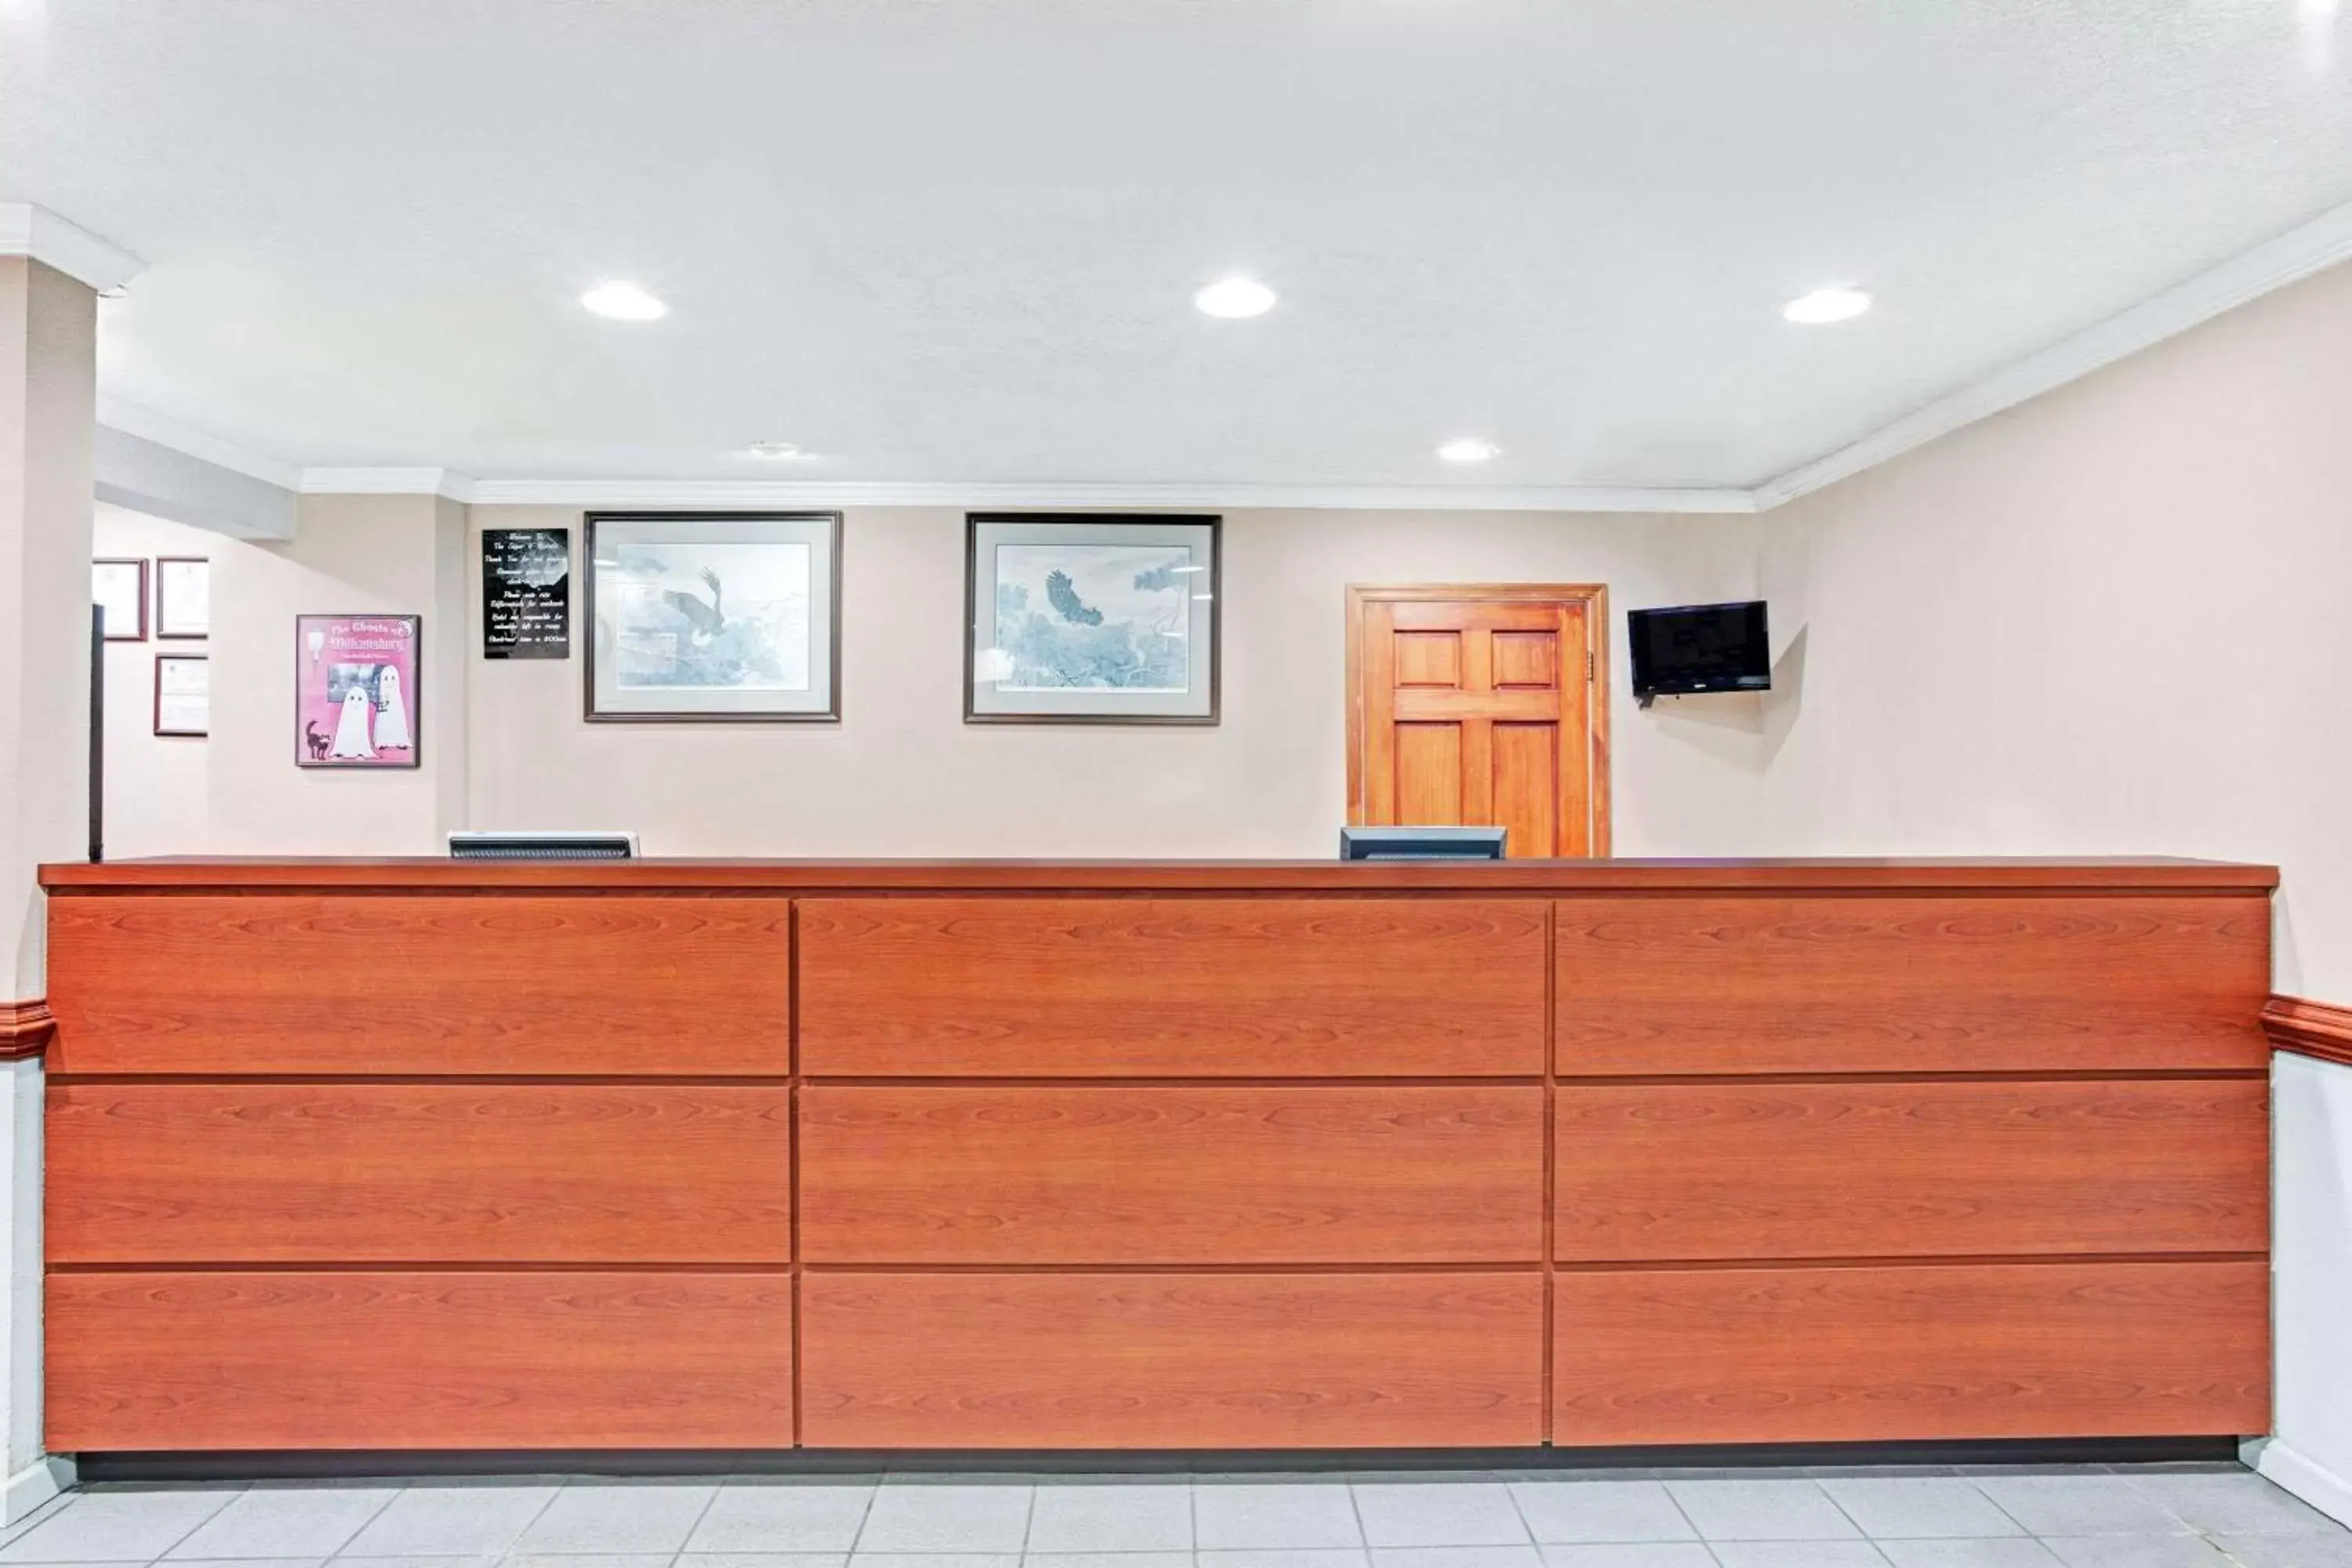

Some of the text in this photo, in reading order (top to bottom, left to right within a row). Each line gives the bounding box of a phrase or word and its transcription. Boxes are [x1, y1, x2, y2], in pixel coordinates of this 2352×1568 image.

[332, 622, 403, 637] The Ghosts of
[328, 636, 404, 652] Williamsburg
